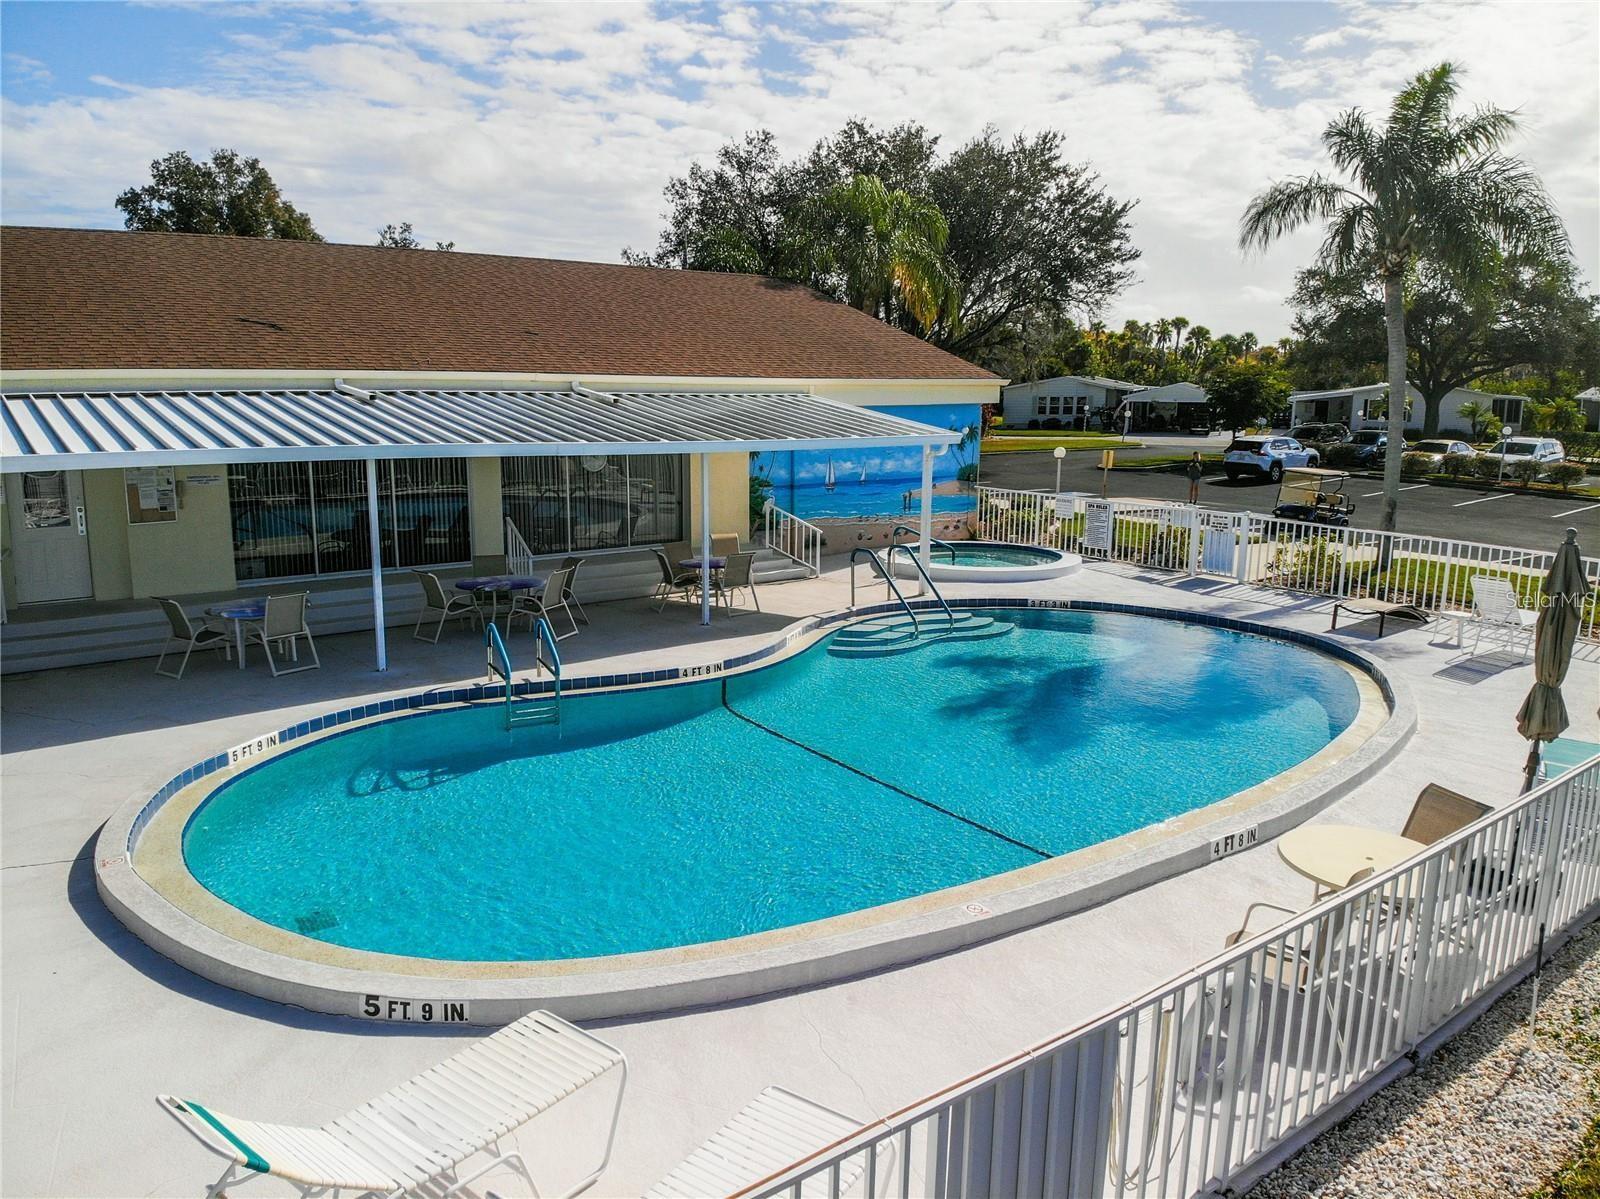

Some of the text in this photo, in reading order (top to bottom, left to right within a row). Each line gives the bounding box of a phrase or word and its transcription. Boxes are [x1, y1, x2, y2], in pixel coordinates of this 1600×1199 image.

[682, 669, 688, 677] 4
[705, 665, 711, 675] 8
[714, 663, 722, 673] IN
[232, 750, 238, 762] 5
[257, 740, 263, 752] 9
[266, 735, 276, 748] IN
[1214, 842, 1220, 856] 4
[1224, 834, 1235, 852] FT
[1238, 833, 1244, 847] 8
[364, 995, 469, 1022] 5 FT. 9 IN.
